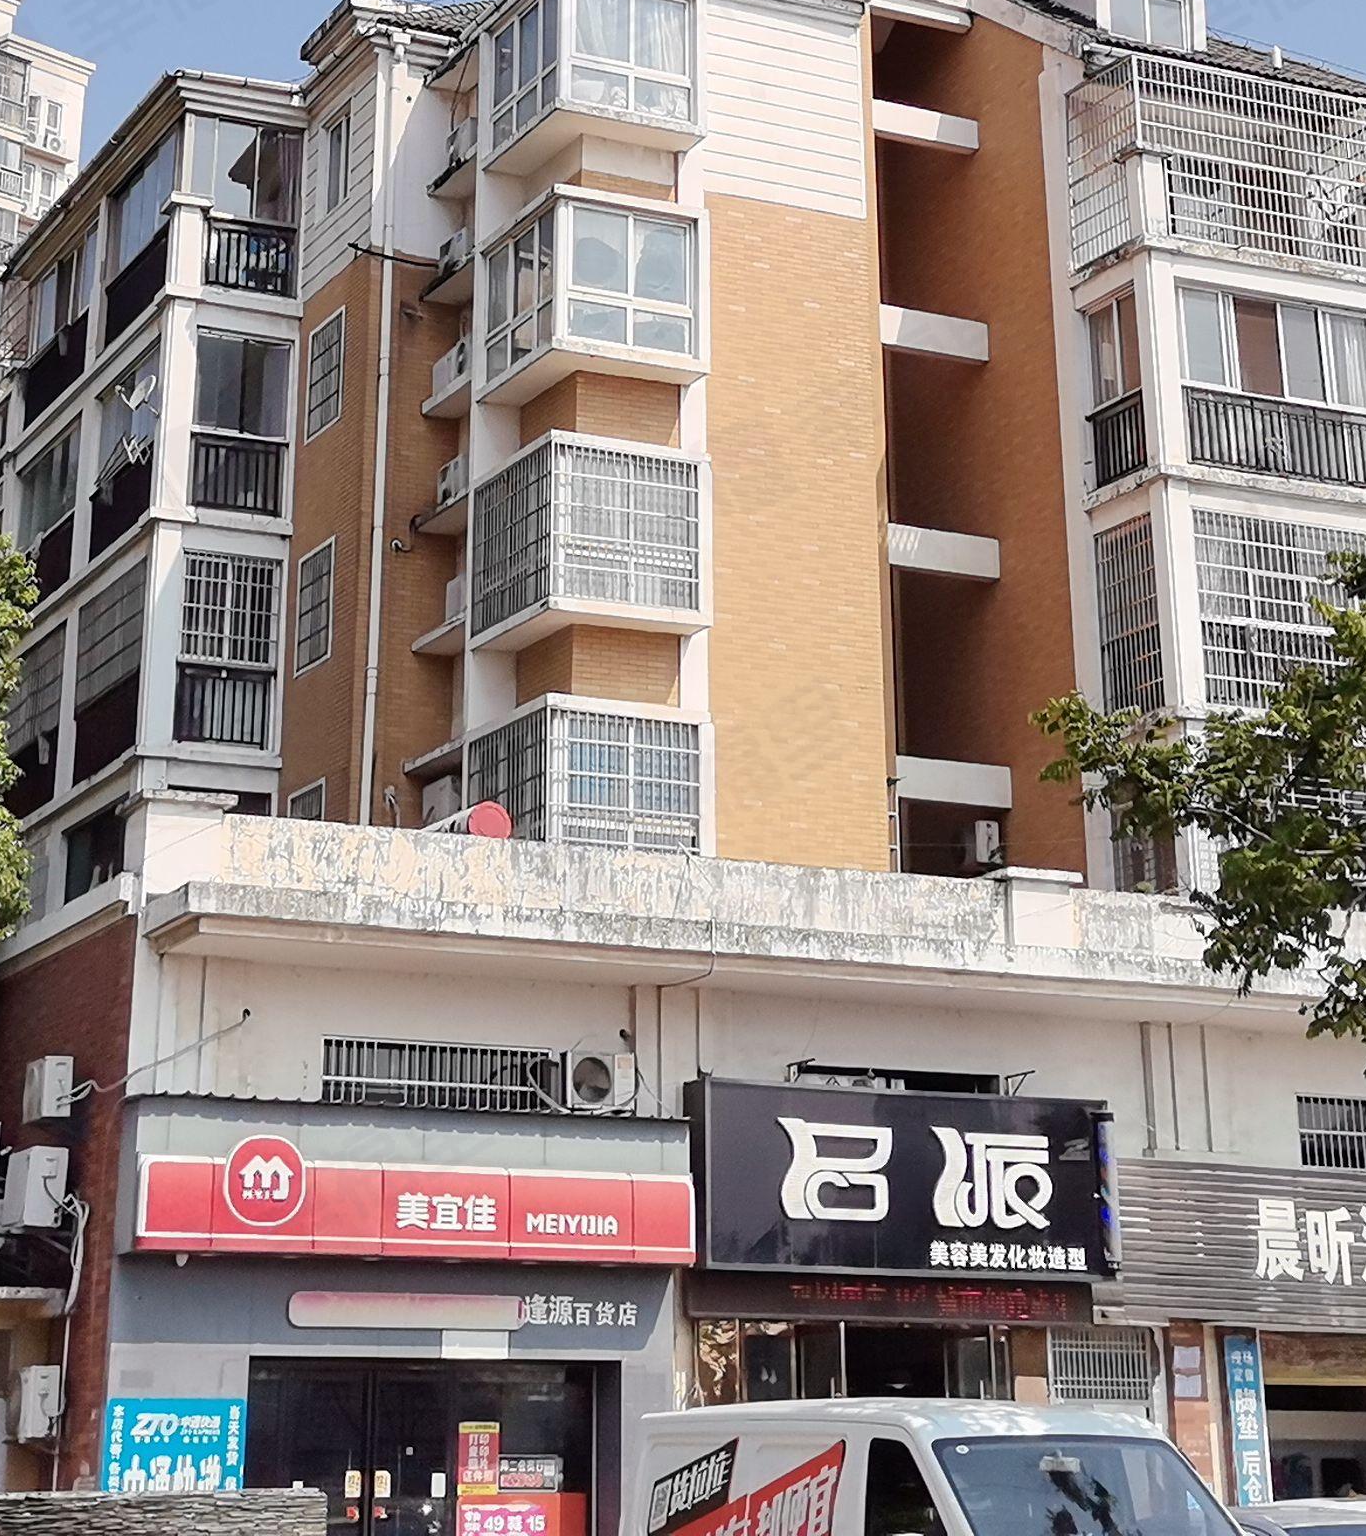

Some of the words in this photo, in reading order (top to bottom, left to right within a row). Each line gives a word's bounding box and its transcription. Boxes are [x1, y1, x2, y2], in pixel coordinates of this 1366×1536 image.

[396, 1191, 497, 1232] 美宜佳
[526, 1213, 618, 1236] MEIYIJIA
[929, 1239, 1088, 1272] 美容美发化妆造型
[130, 1413, 179, 1436] ZTO
